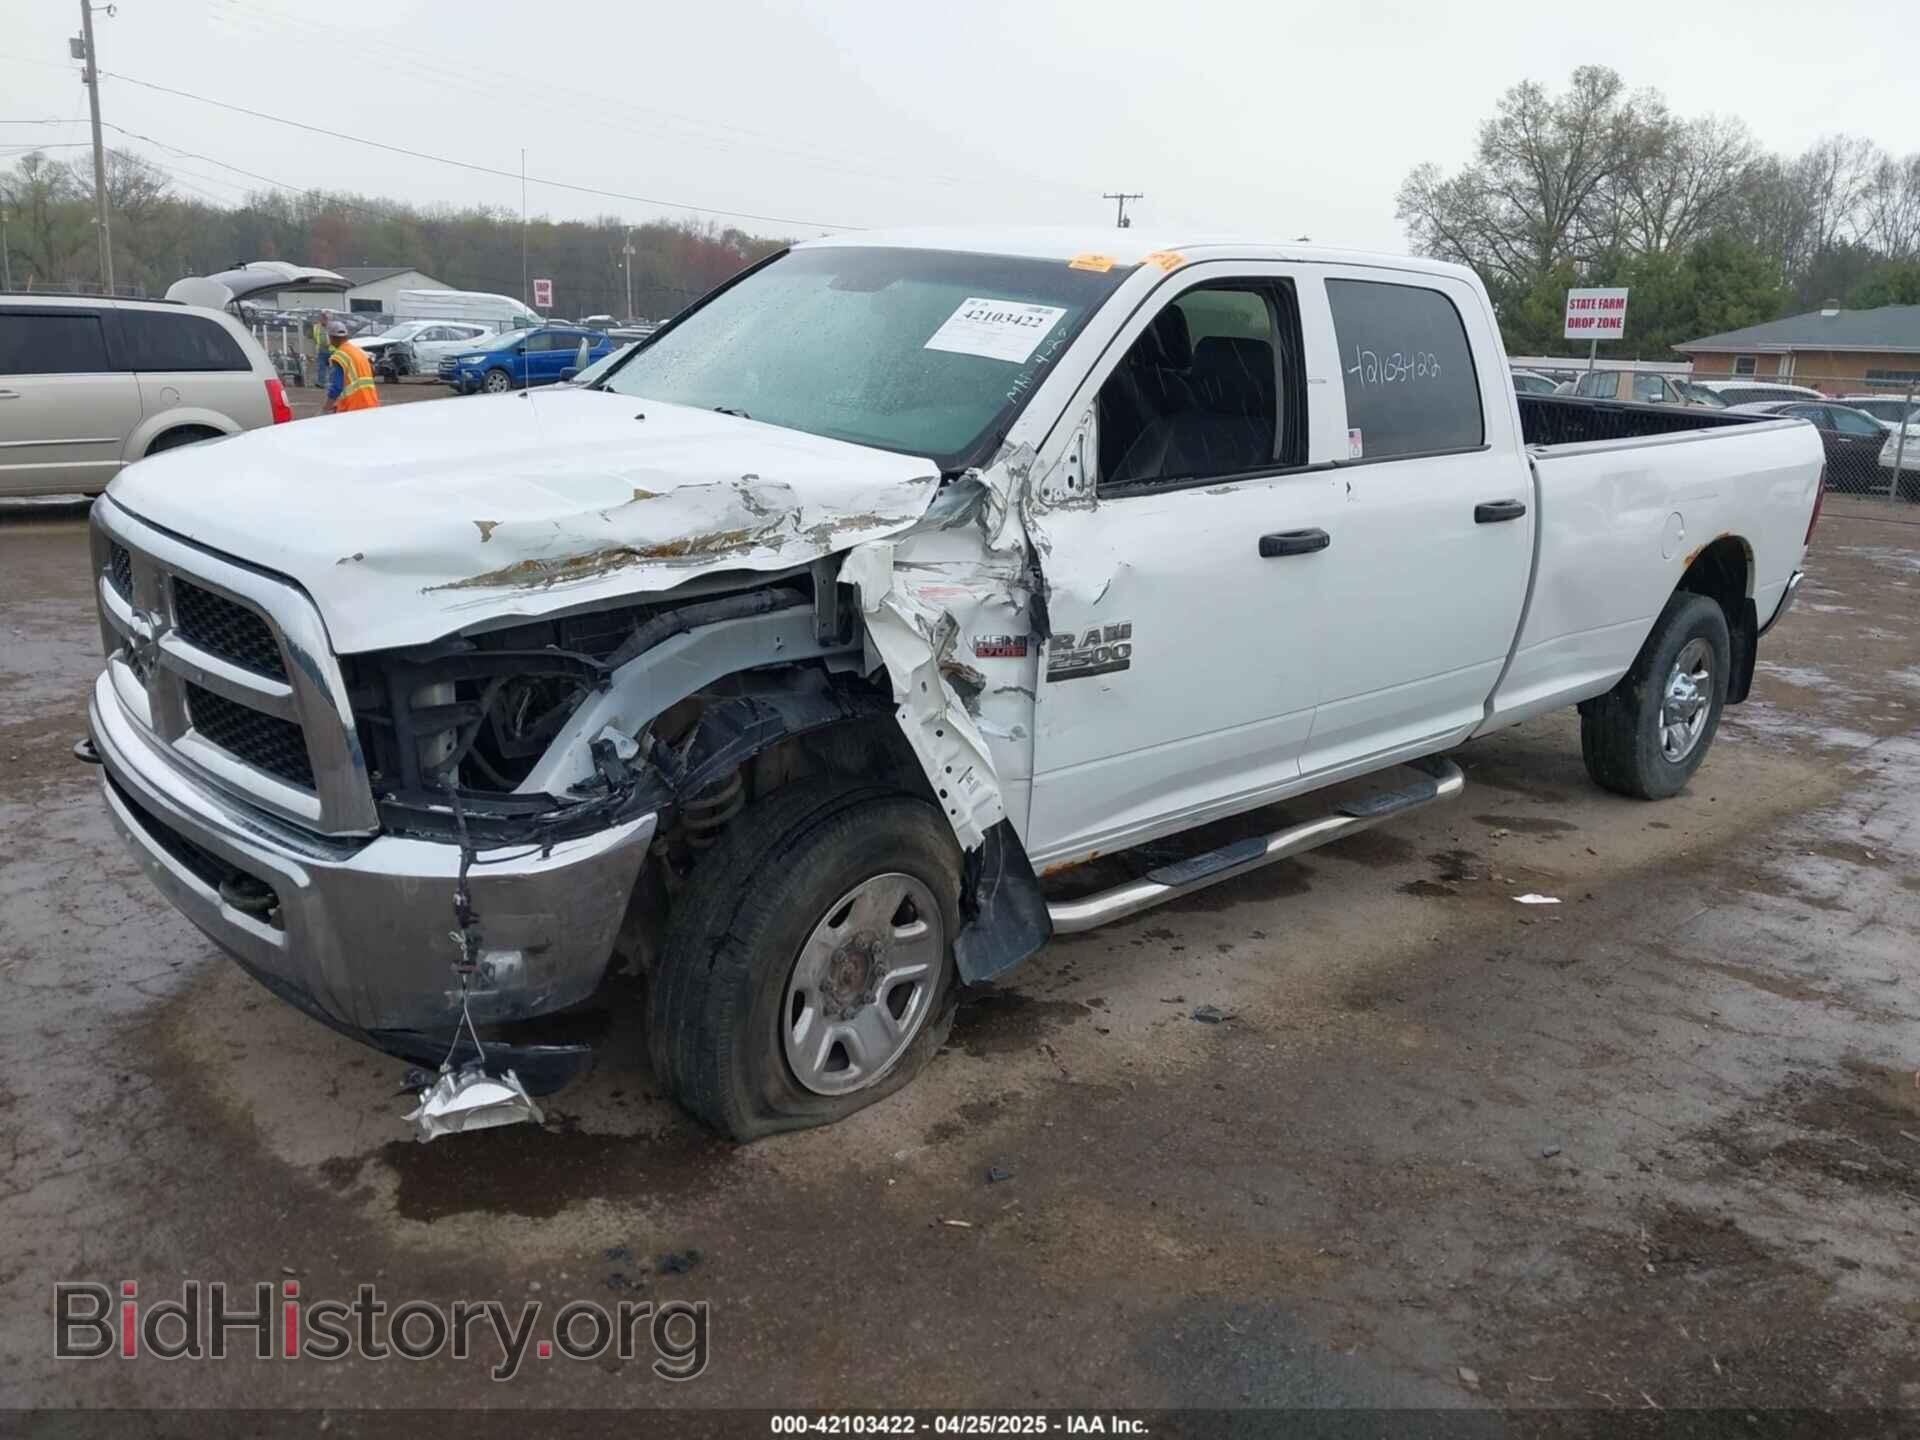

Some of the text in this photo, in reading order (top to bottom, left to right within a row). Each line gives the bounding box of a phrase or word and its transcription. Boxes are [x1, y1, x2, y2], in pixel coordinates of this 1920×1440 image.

[1569, 298, 1625, 310] STATE FARM
[964, 310, 1043, 328] 42103422
[1568, 317, 1623, 328] DROP ZONE
[1050, 623, 1133, 651] RAM
[1049, 643, 1133, 670] 2500
